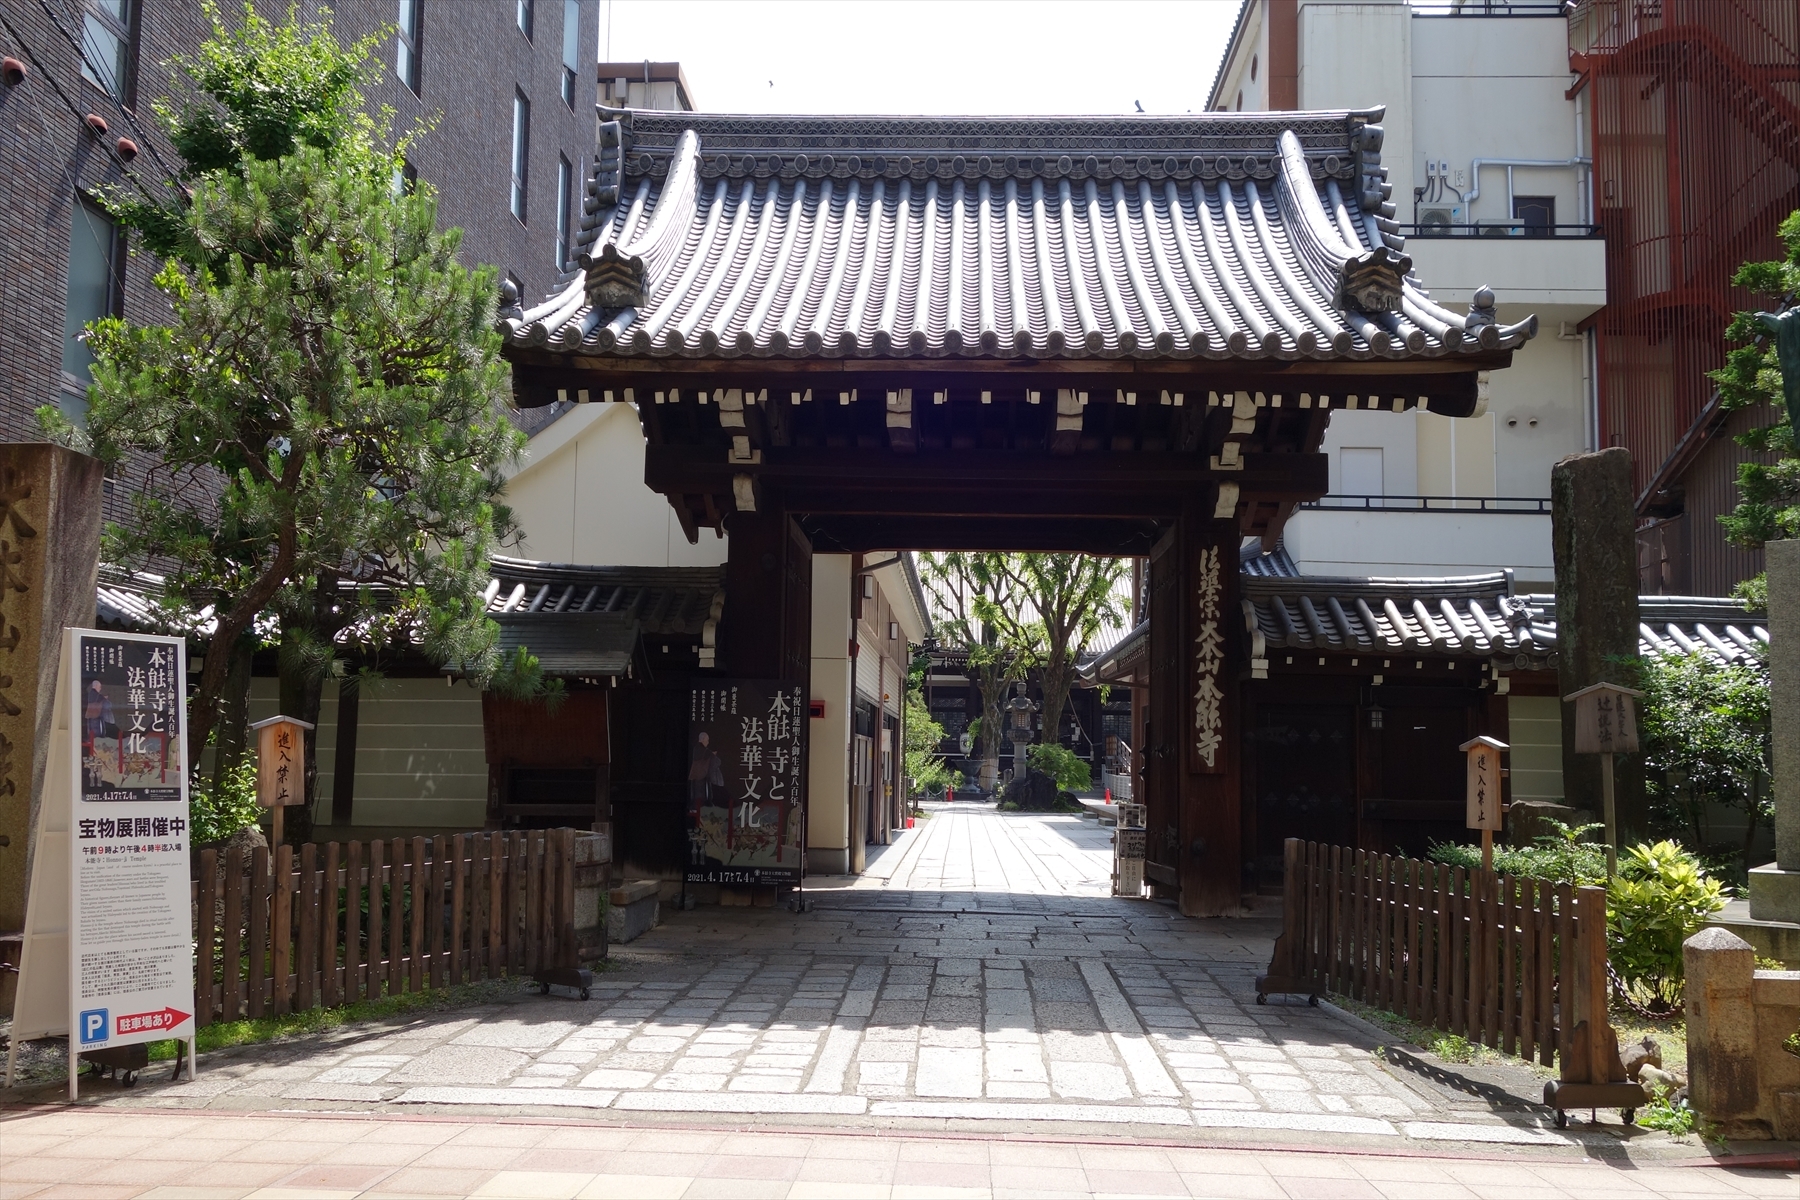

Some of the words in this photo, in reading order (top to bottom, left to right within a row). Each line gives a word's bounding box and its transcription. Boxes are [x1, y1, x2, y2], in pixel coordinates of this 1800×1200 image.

[127, 665, 147, 755] 法華文化
[147, 646, 167, 733] 本能寺と
[1598, 696, 1613, 744] 辻説法
[276, 731, 292, 800] 進入禁止
[738, 716, 764, 829] 法華文化
[766, 689, 791, 801] 本能寺と
[1477, 754, 1486, 822] 進入禁止
[78, 816, 186, 839] 宝物展開催中
[88, 1014, 104, 1039] P
[120, 1013, 173, 1032] 駐車場あり
